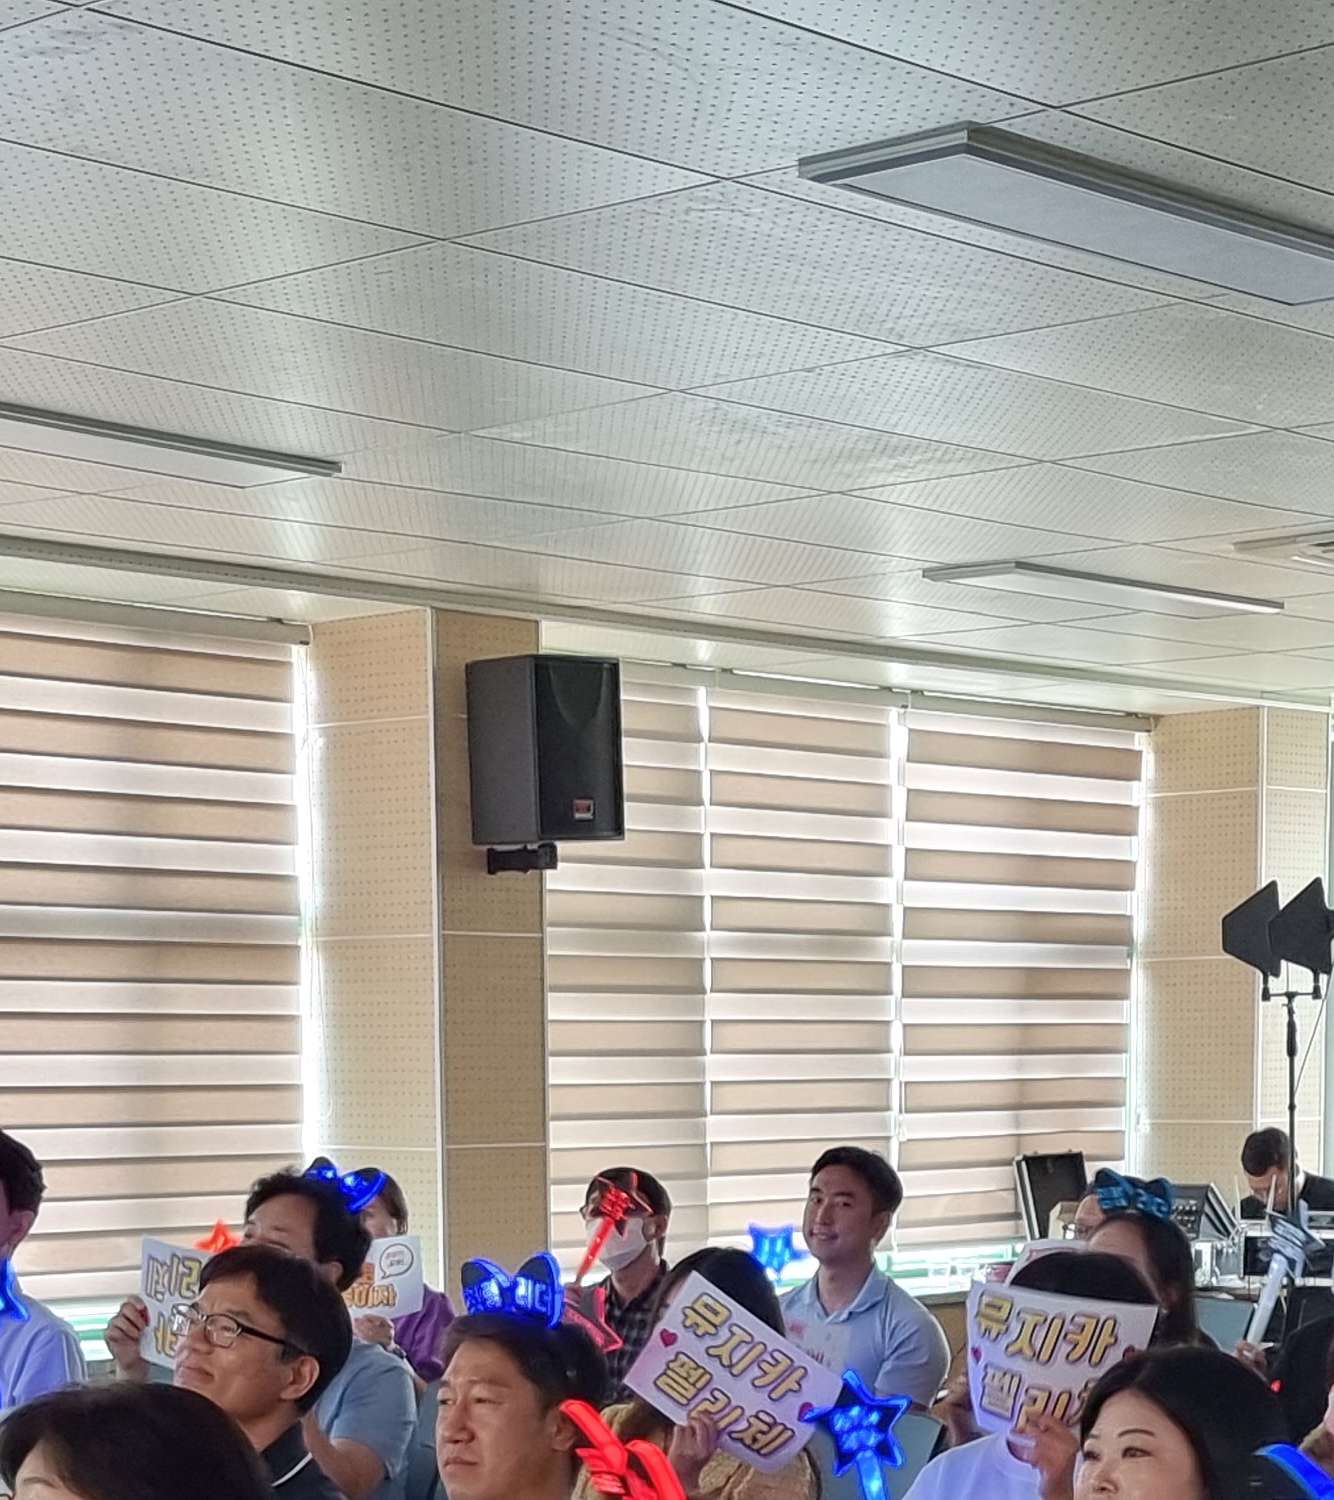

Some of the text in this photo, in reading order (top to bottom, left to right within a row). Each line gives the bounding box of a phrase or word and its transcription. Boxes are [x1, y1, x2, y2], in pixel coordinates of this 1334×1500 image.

[681, 1291, 809, 1401] 뮤지카
[976, 1289, 1120, 1367] 뮤지카
[653, 1350, 796, 1457] 펠리체
